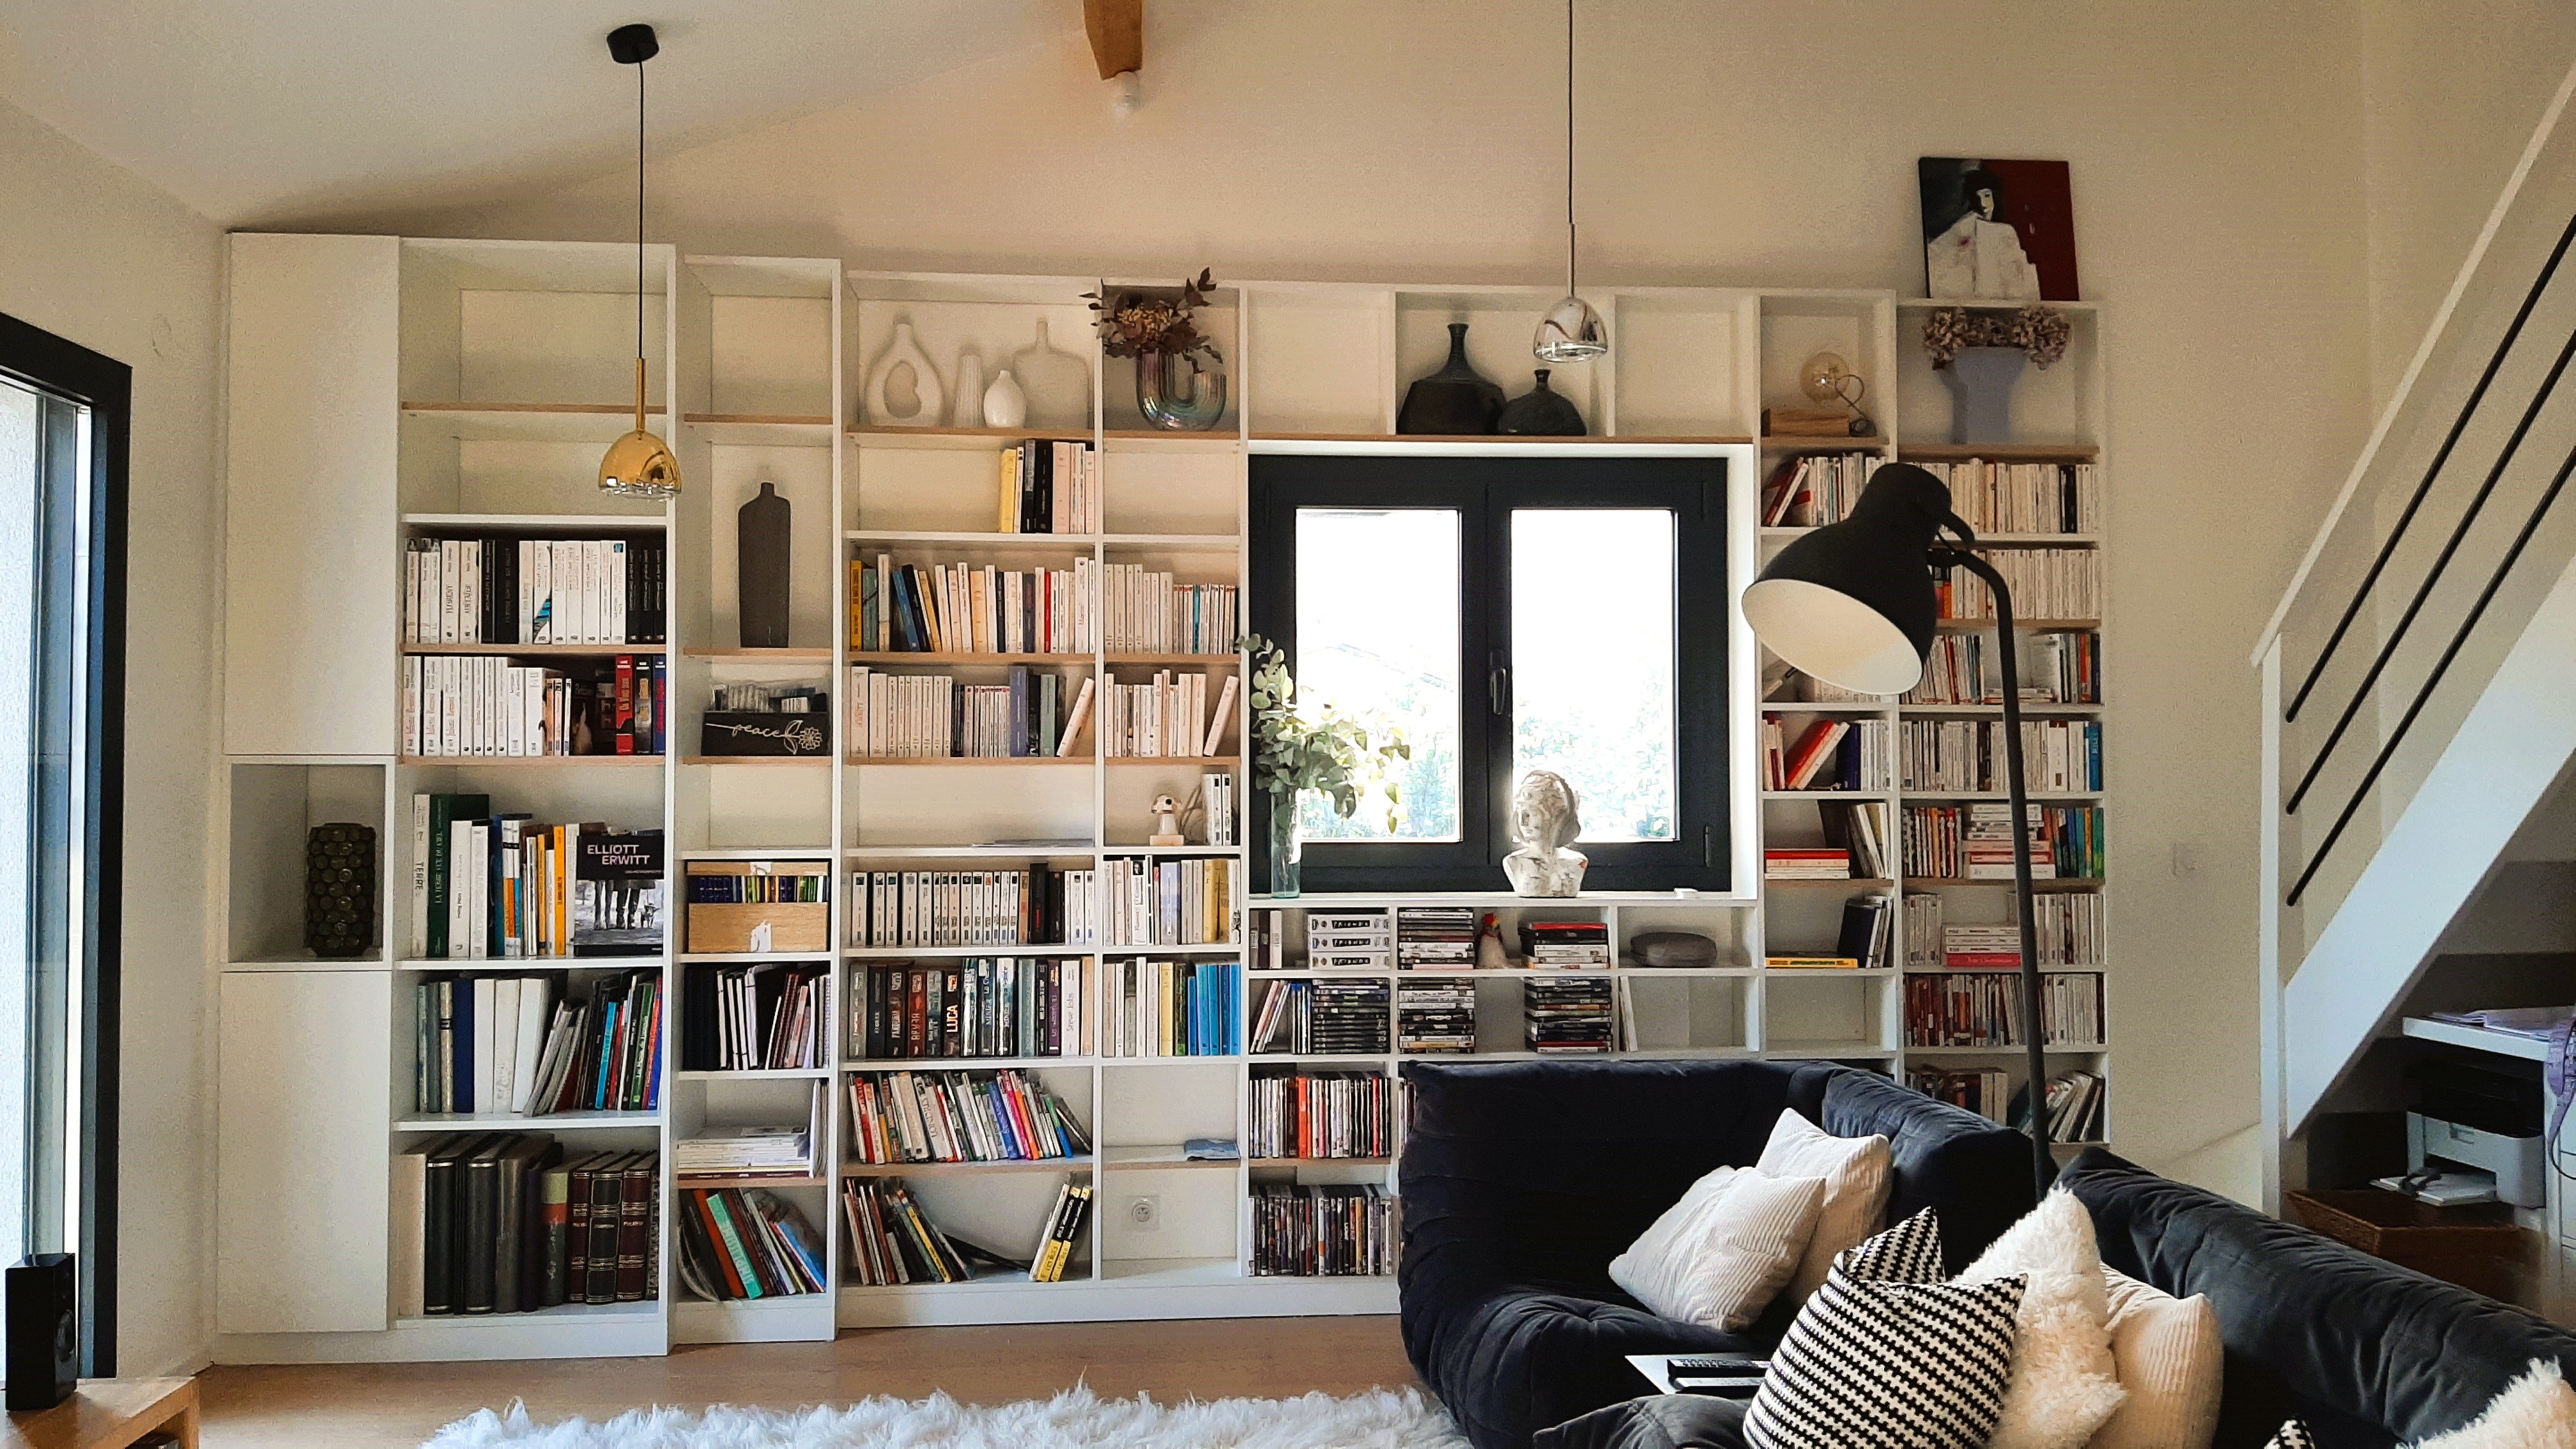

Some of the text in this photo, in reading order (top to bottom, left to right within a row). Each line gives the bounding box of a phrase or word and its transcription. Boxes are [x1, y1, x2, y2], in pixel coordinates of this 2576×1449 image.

[732, 722, 783, 738] peace
[587, 844, 640, 855] ELLIOTT
[602, 855, 650, 865] ERWITT
[946, 1004, 958, 1032] LUCA
